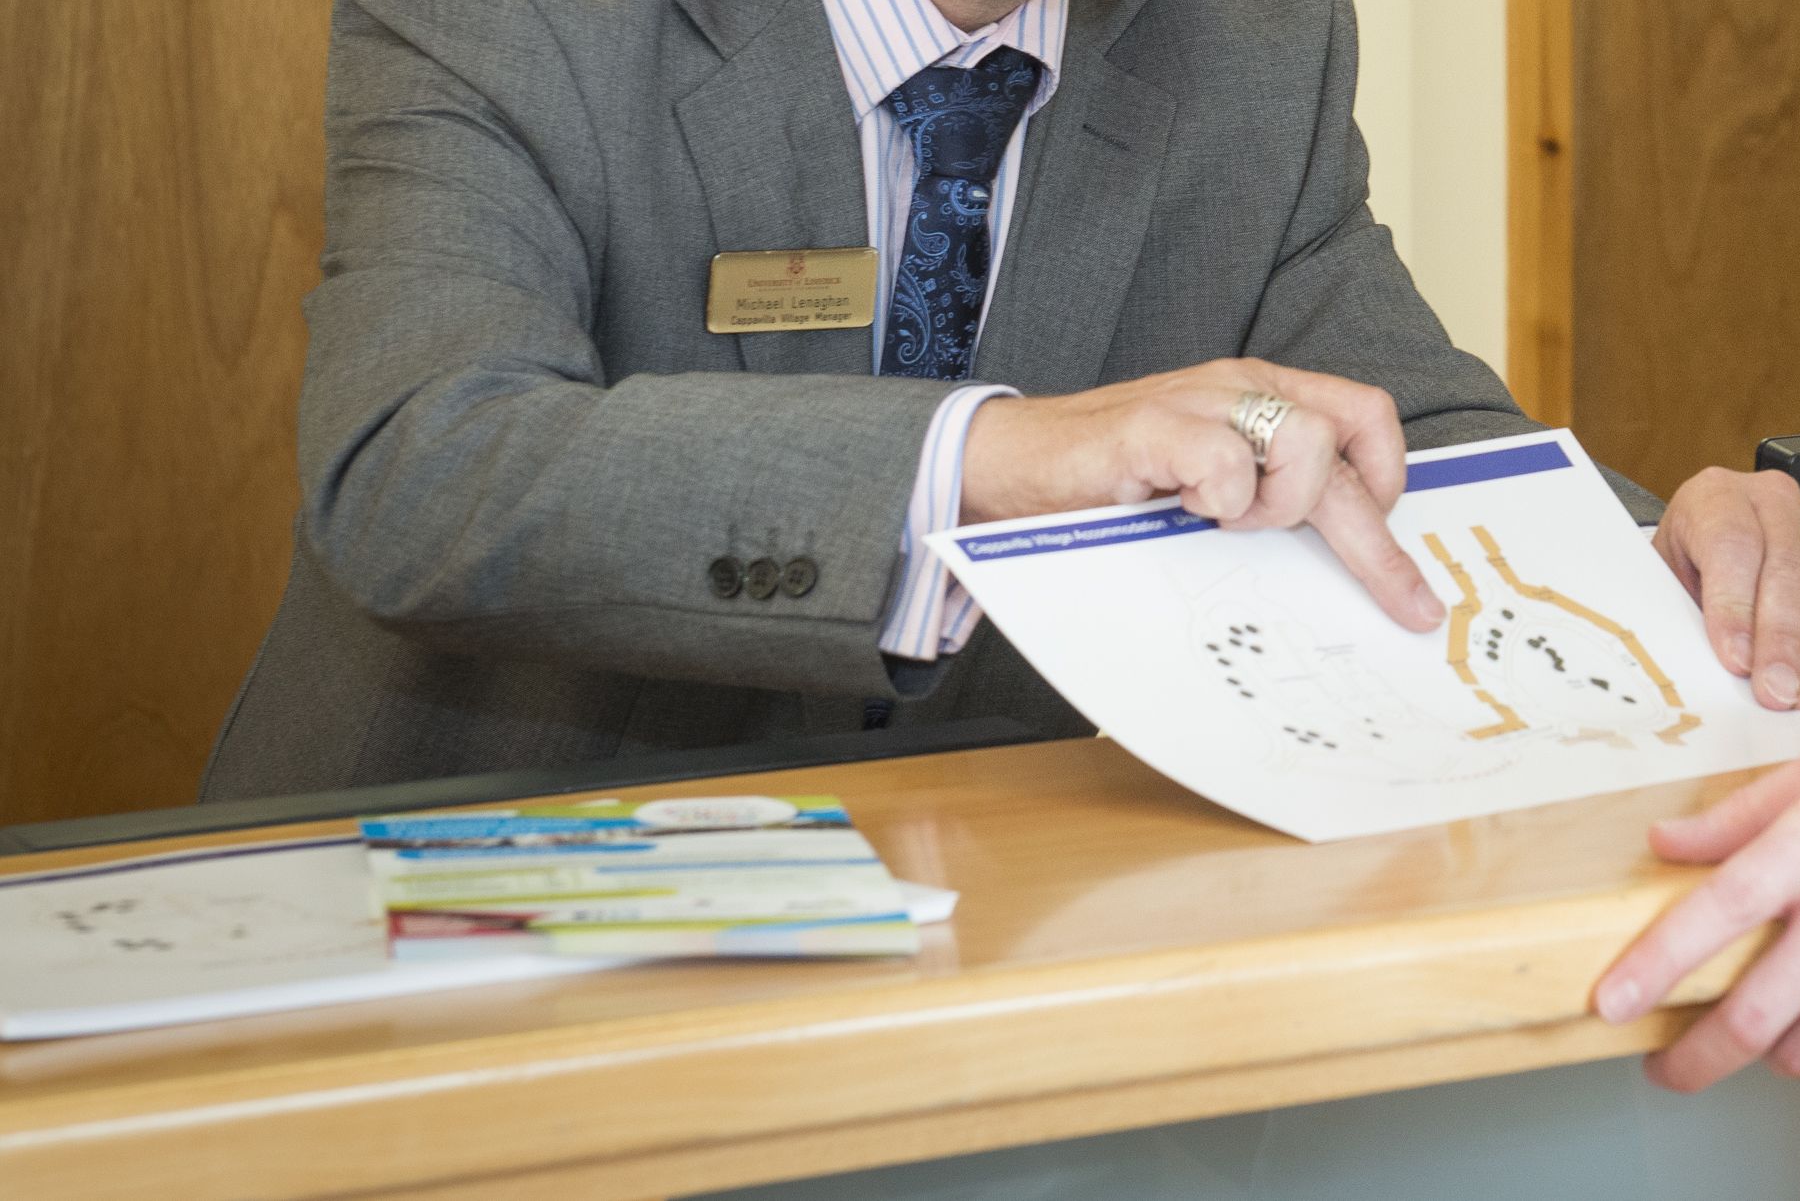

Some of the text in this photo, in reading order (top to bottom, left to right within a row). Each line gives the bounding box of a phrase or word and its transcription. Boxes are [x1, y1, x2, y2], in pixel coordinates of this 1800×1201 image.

[736, 296, 850, 311] Michael Lenaghan
[815, 312, 852, 323] Manager
